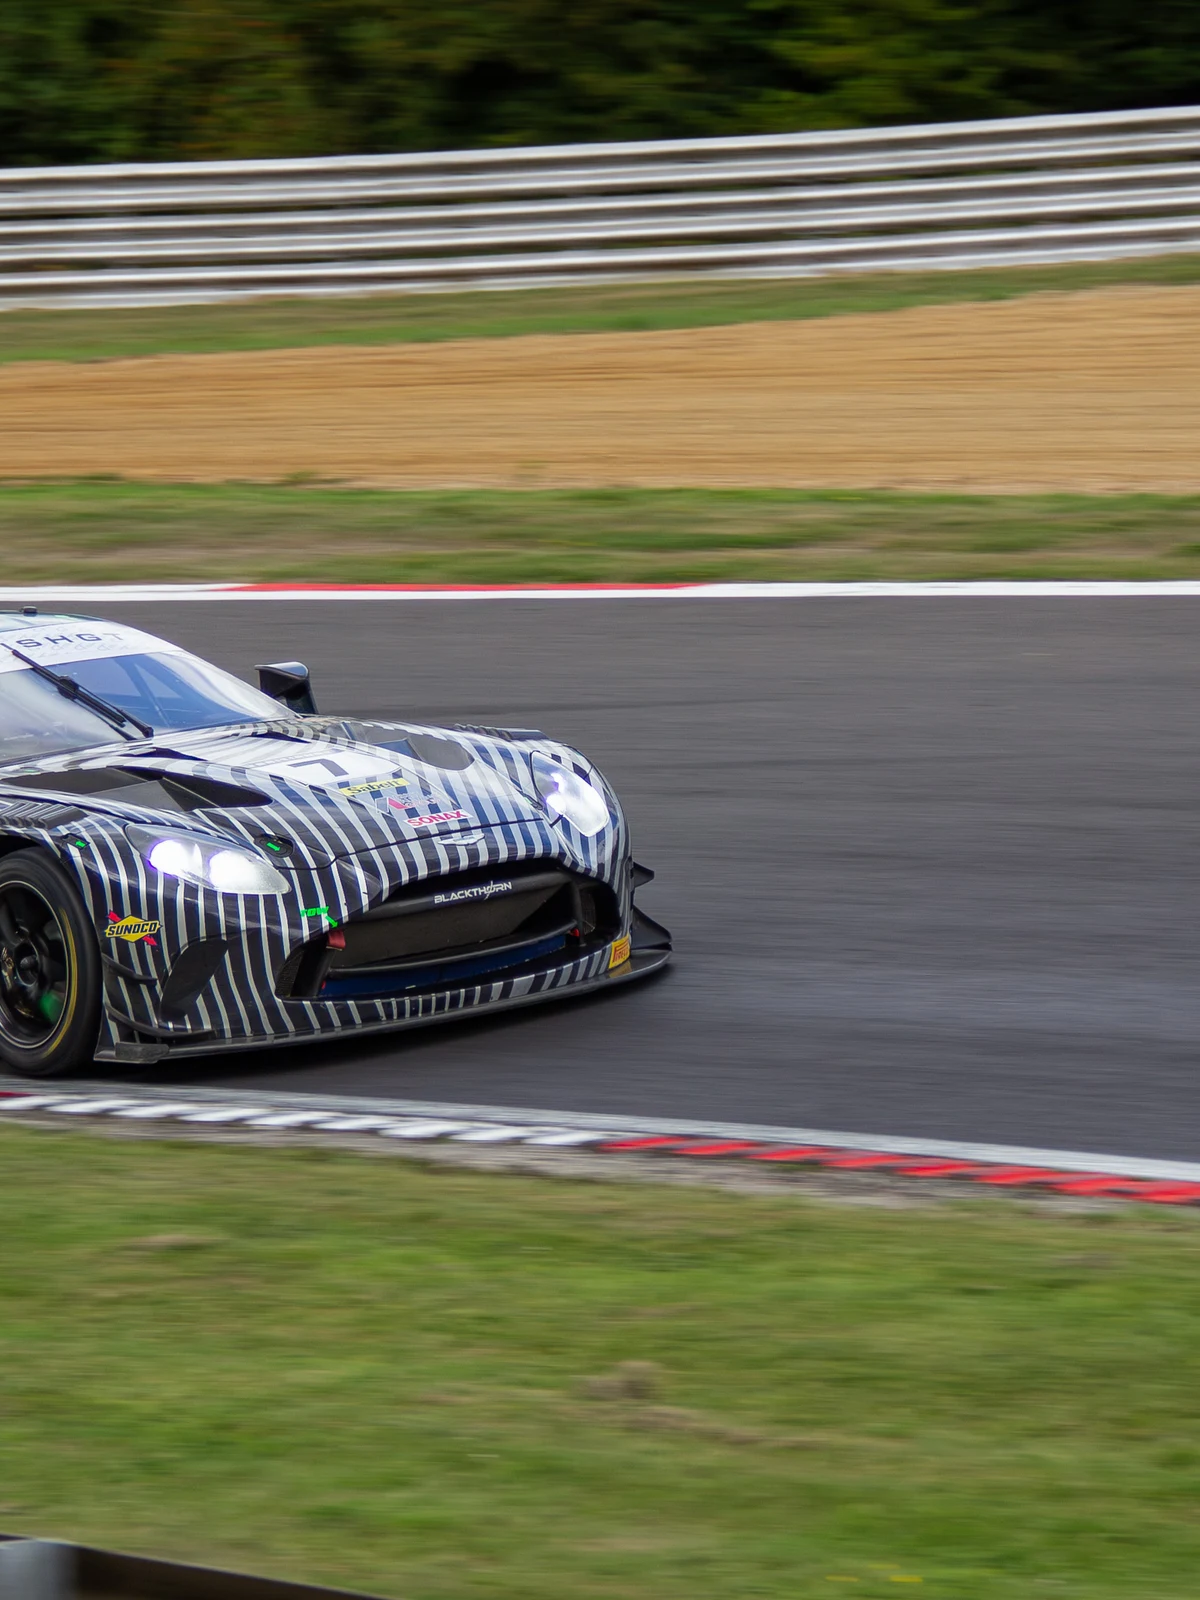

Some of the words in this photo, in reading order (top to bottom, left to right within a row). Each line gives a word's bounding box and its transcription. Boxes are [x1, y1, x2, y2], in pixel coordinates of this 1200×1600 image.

[287, 758, 349, 777] 7
[407, 810, 467, 826] SONAX
[434, 880, 512, 904] BLACKTHORN
[108, 920, 157, 936] SUNOCO
